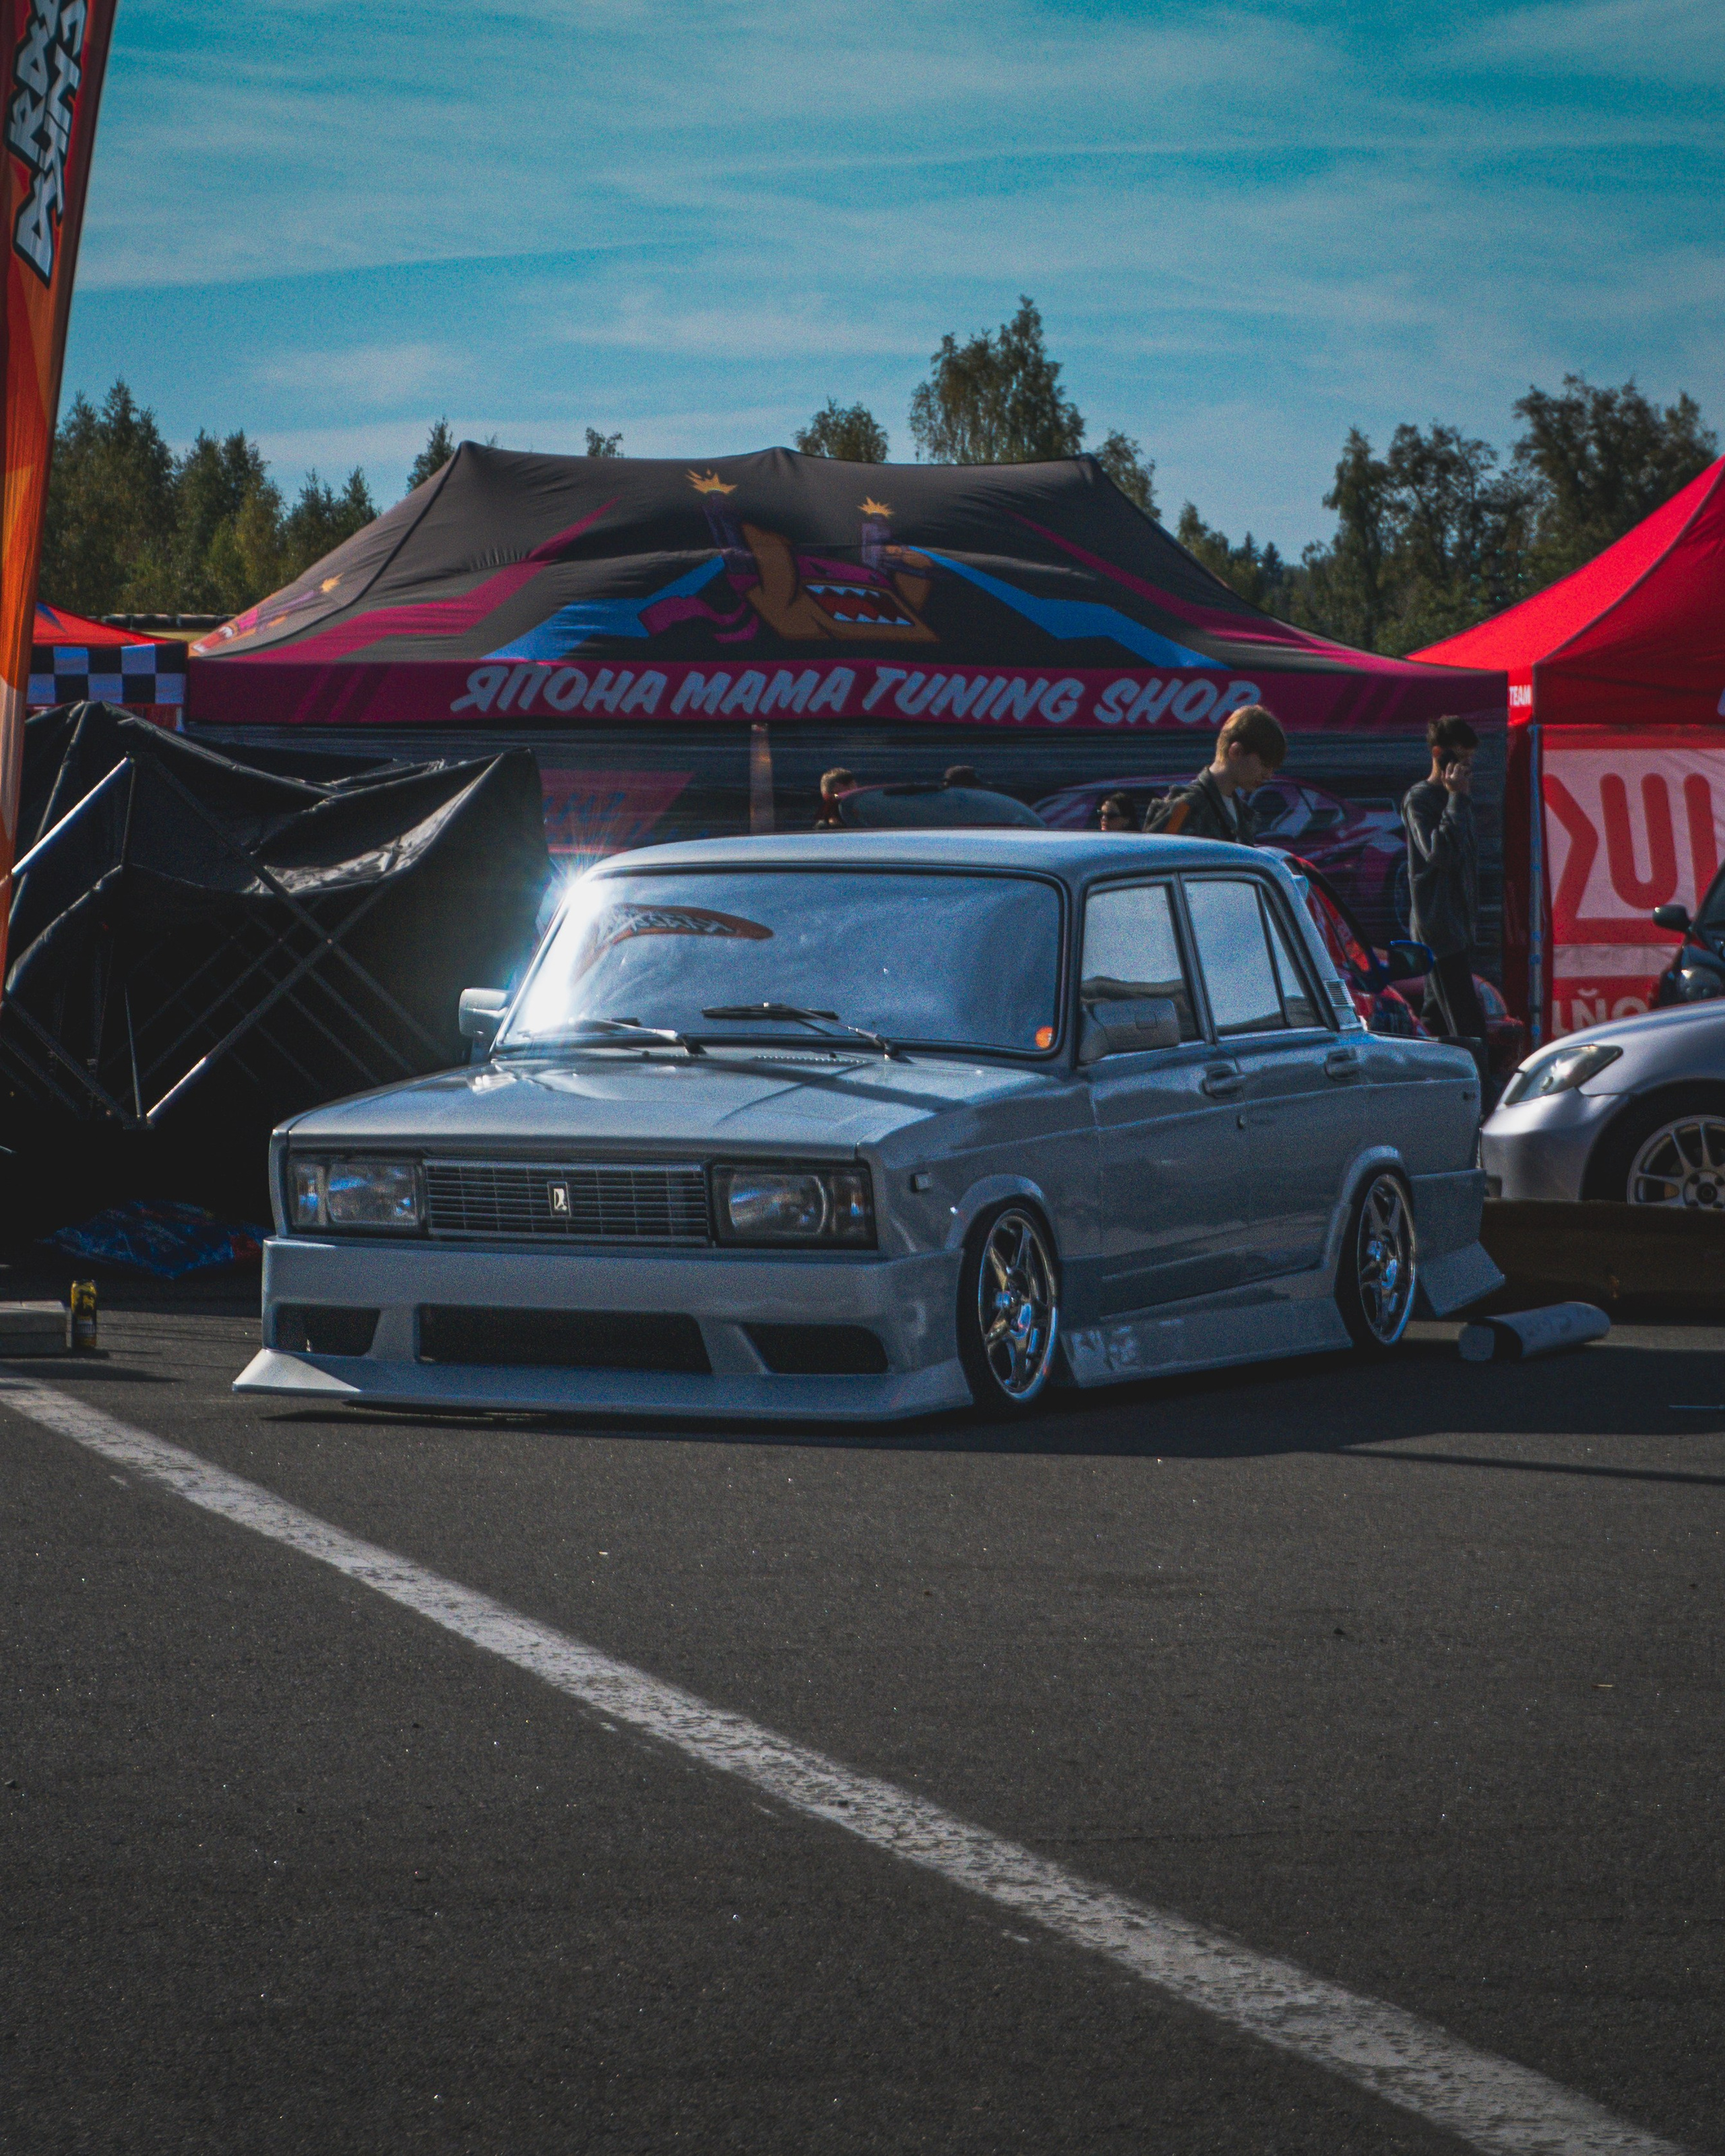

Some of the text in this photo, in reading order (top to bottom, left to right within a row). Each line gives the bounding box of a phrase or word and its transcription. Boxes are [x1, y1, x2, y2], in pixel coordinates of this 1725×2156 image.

[450, 663, 1261, 724] ЯПОНА МАМА TUNING SHOP
[1509, 684, 1532, 707] TEAM
